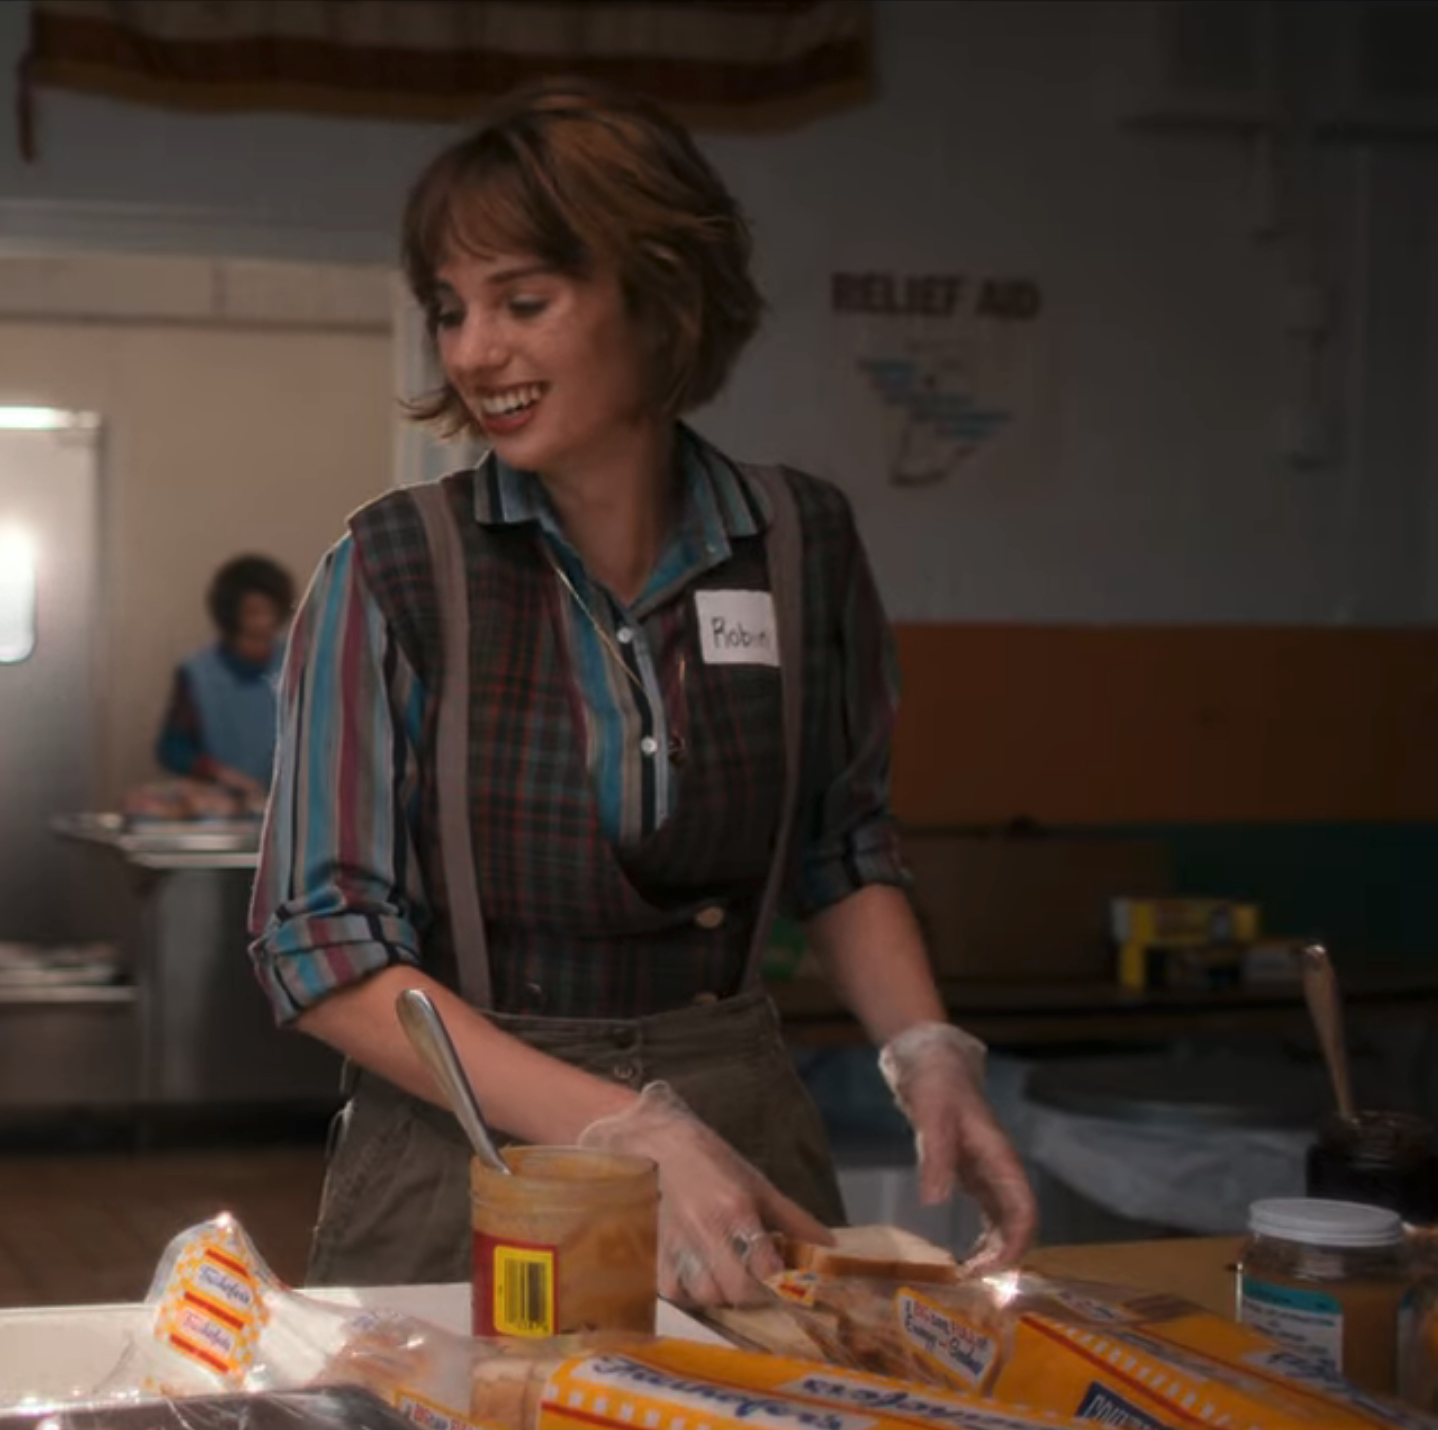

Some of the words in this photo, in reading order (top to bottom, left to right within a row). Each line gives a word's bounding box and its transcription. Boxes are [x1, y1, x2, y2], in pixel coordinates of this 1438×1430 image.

[830, 271, 965, 317] RELIEF
[975, 278, 1043, 322] AID
[711, 616, 771, 650] Robin
